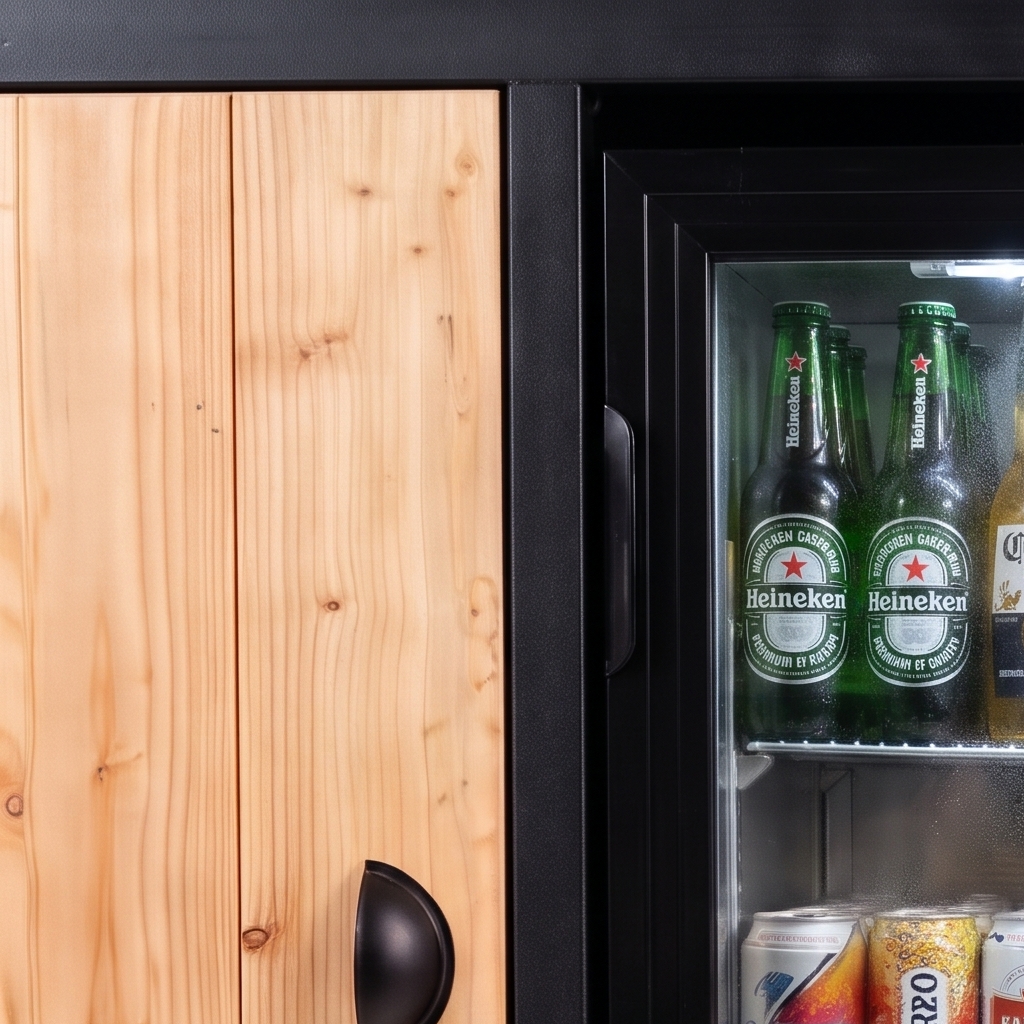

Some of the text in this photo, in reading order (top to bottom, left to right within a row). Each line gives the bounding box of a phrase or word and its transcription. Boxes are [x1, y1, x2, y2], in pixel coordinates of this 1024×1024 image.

[786, 375, 800, 448] Heineken
[911, 376, 926, 450] Heineken
[746, 588, 846, 609] Heineken
[868, 590, 967, 612] Heineken
